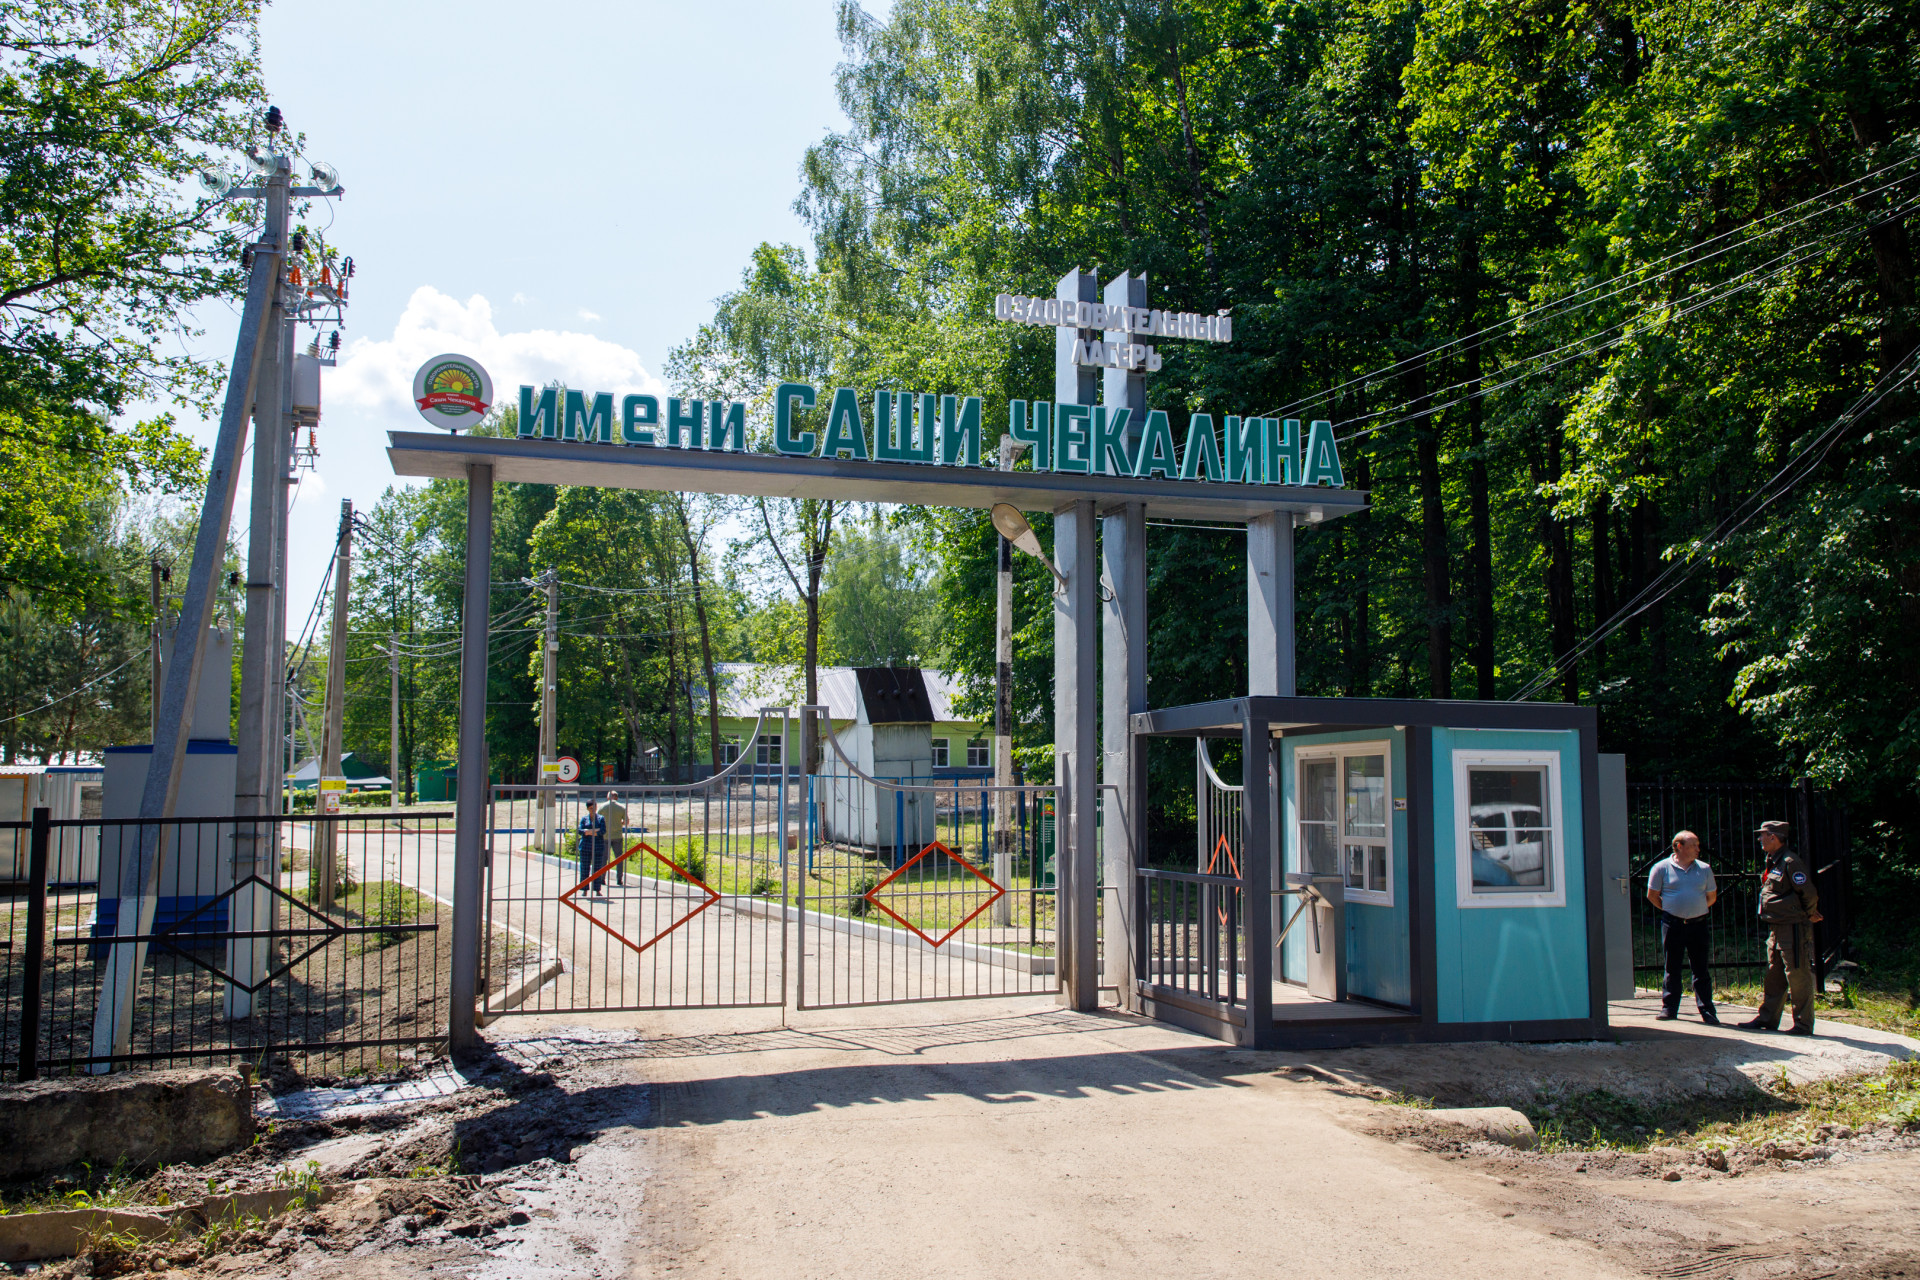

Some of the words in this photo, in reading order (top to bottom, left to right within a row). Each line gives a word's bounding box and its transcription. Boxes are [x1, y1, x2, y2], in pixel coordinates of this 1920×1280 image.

[995, 294, 1233, 343] ОЗДОРОВИТЕЛЬНЫЙ
[1072, 339, 1162, 372] ЛАГЕРЬ
[773, 382, 982, 466] САШИ
[1010, 399, 1345, 487] ЧЕКАЛИНА
[564, 765, 571, 774] 5
